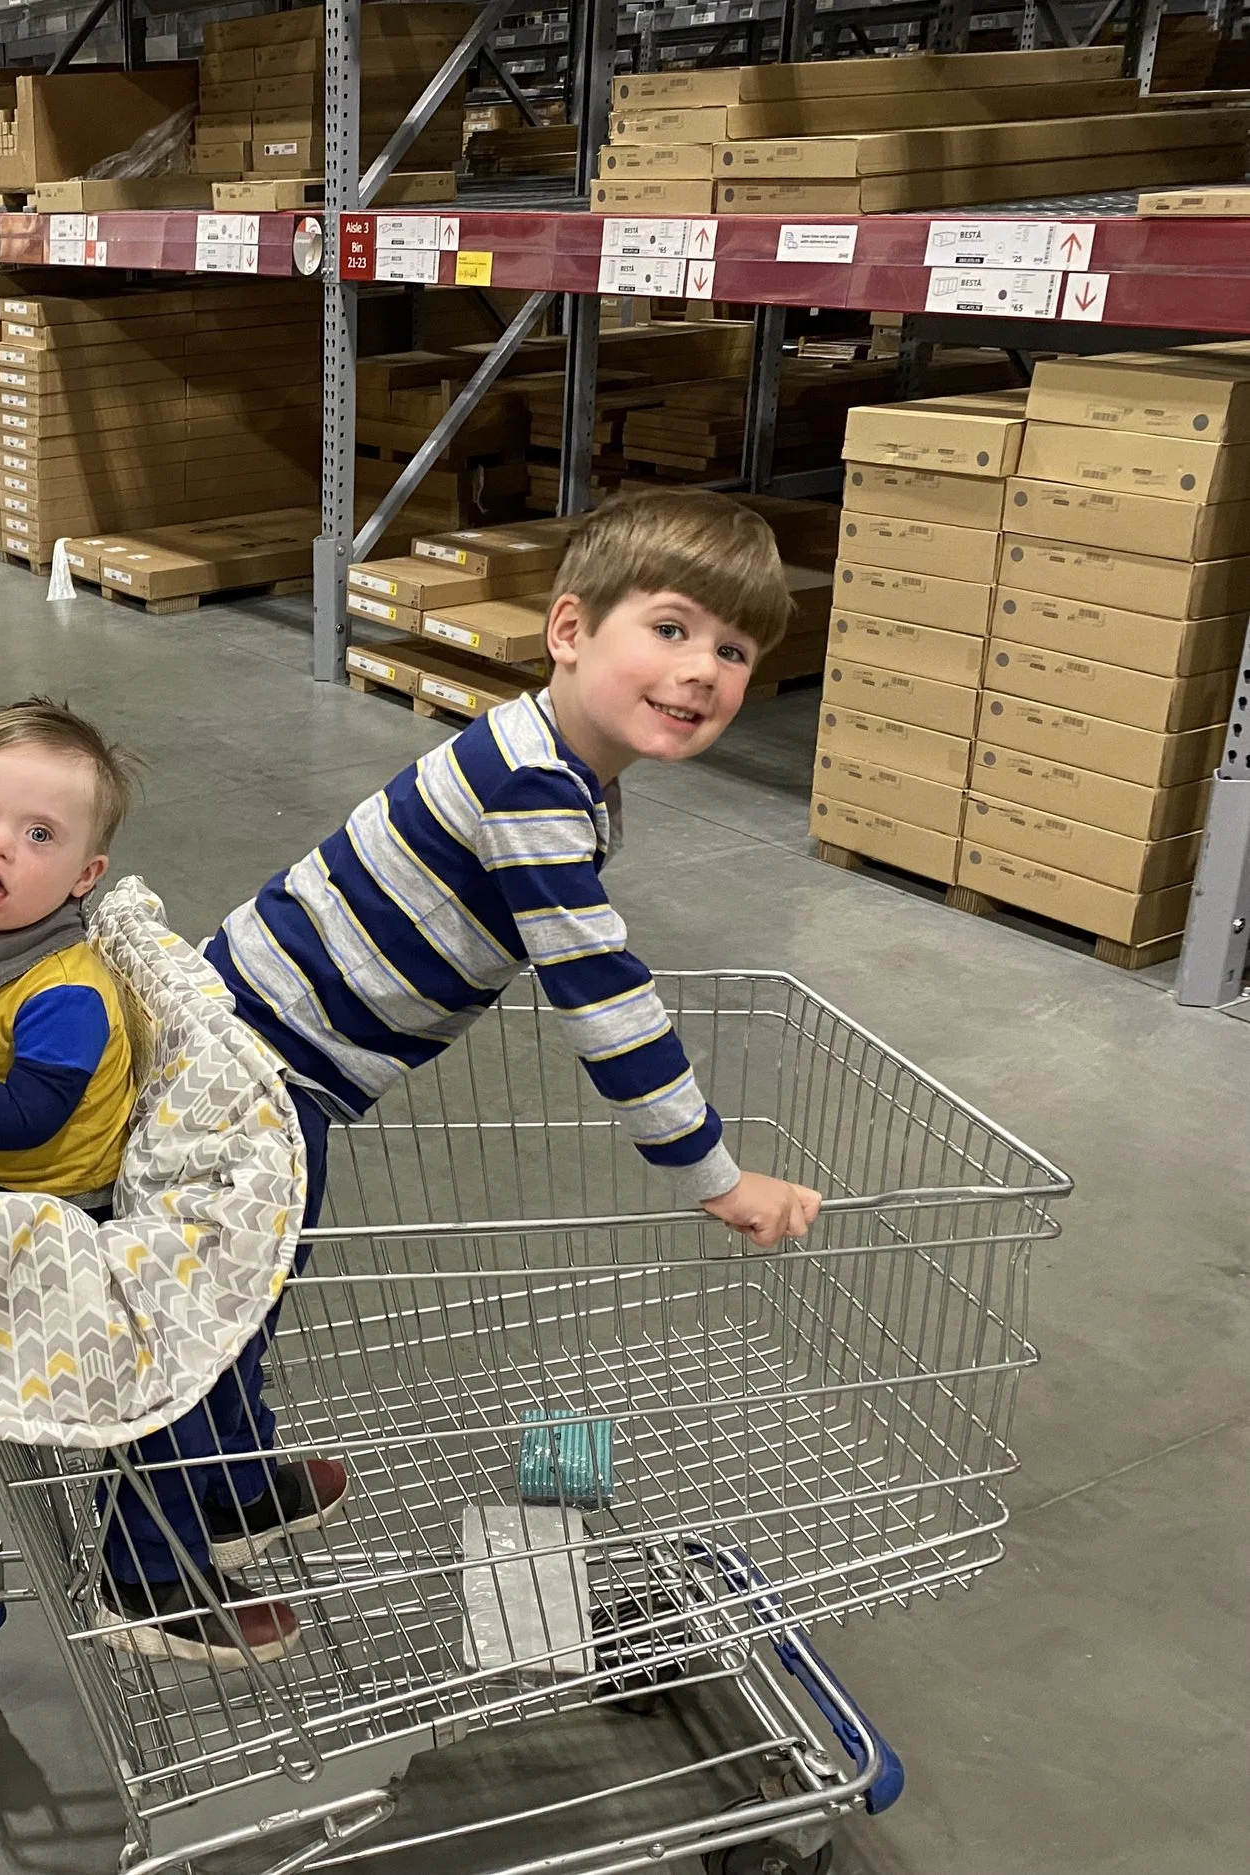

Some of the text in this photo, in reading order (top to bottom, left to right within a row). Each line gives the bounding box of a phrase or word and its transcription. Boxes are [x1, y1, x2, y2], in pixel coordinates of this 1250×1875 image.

[345, 221, 369, 234] Aisle 3
[959, 230, 981, 239] BESTÅ
[351, 241, 363, 253] Bin
[347, 256, 367, 269] 21-23
[960, 278, 982, 287] BESTÅ
